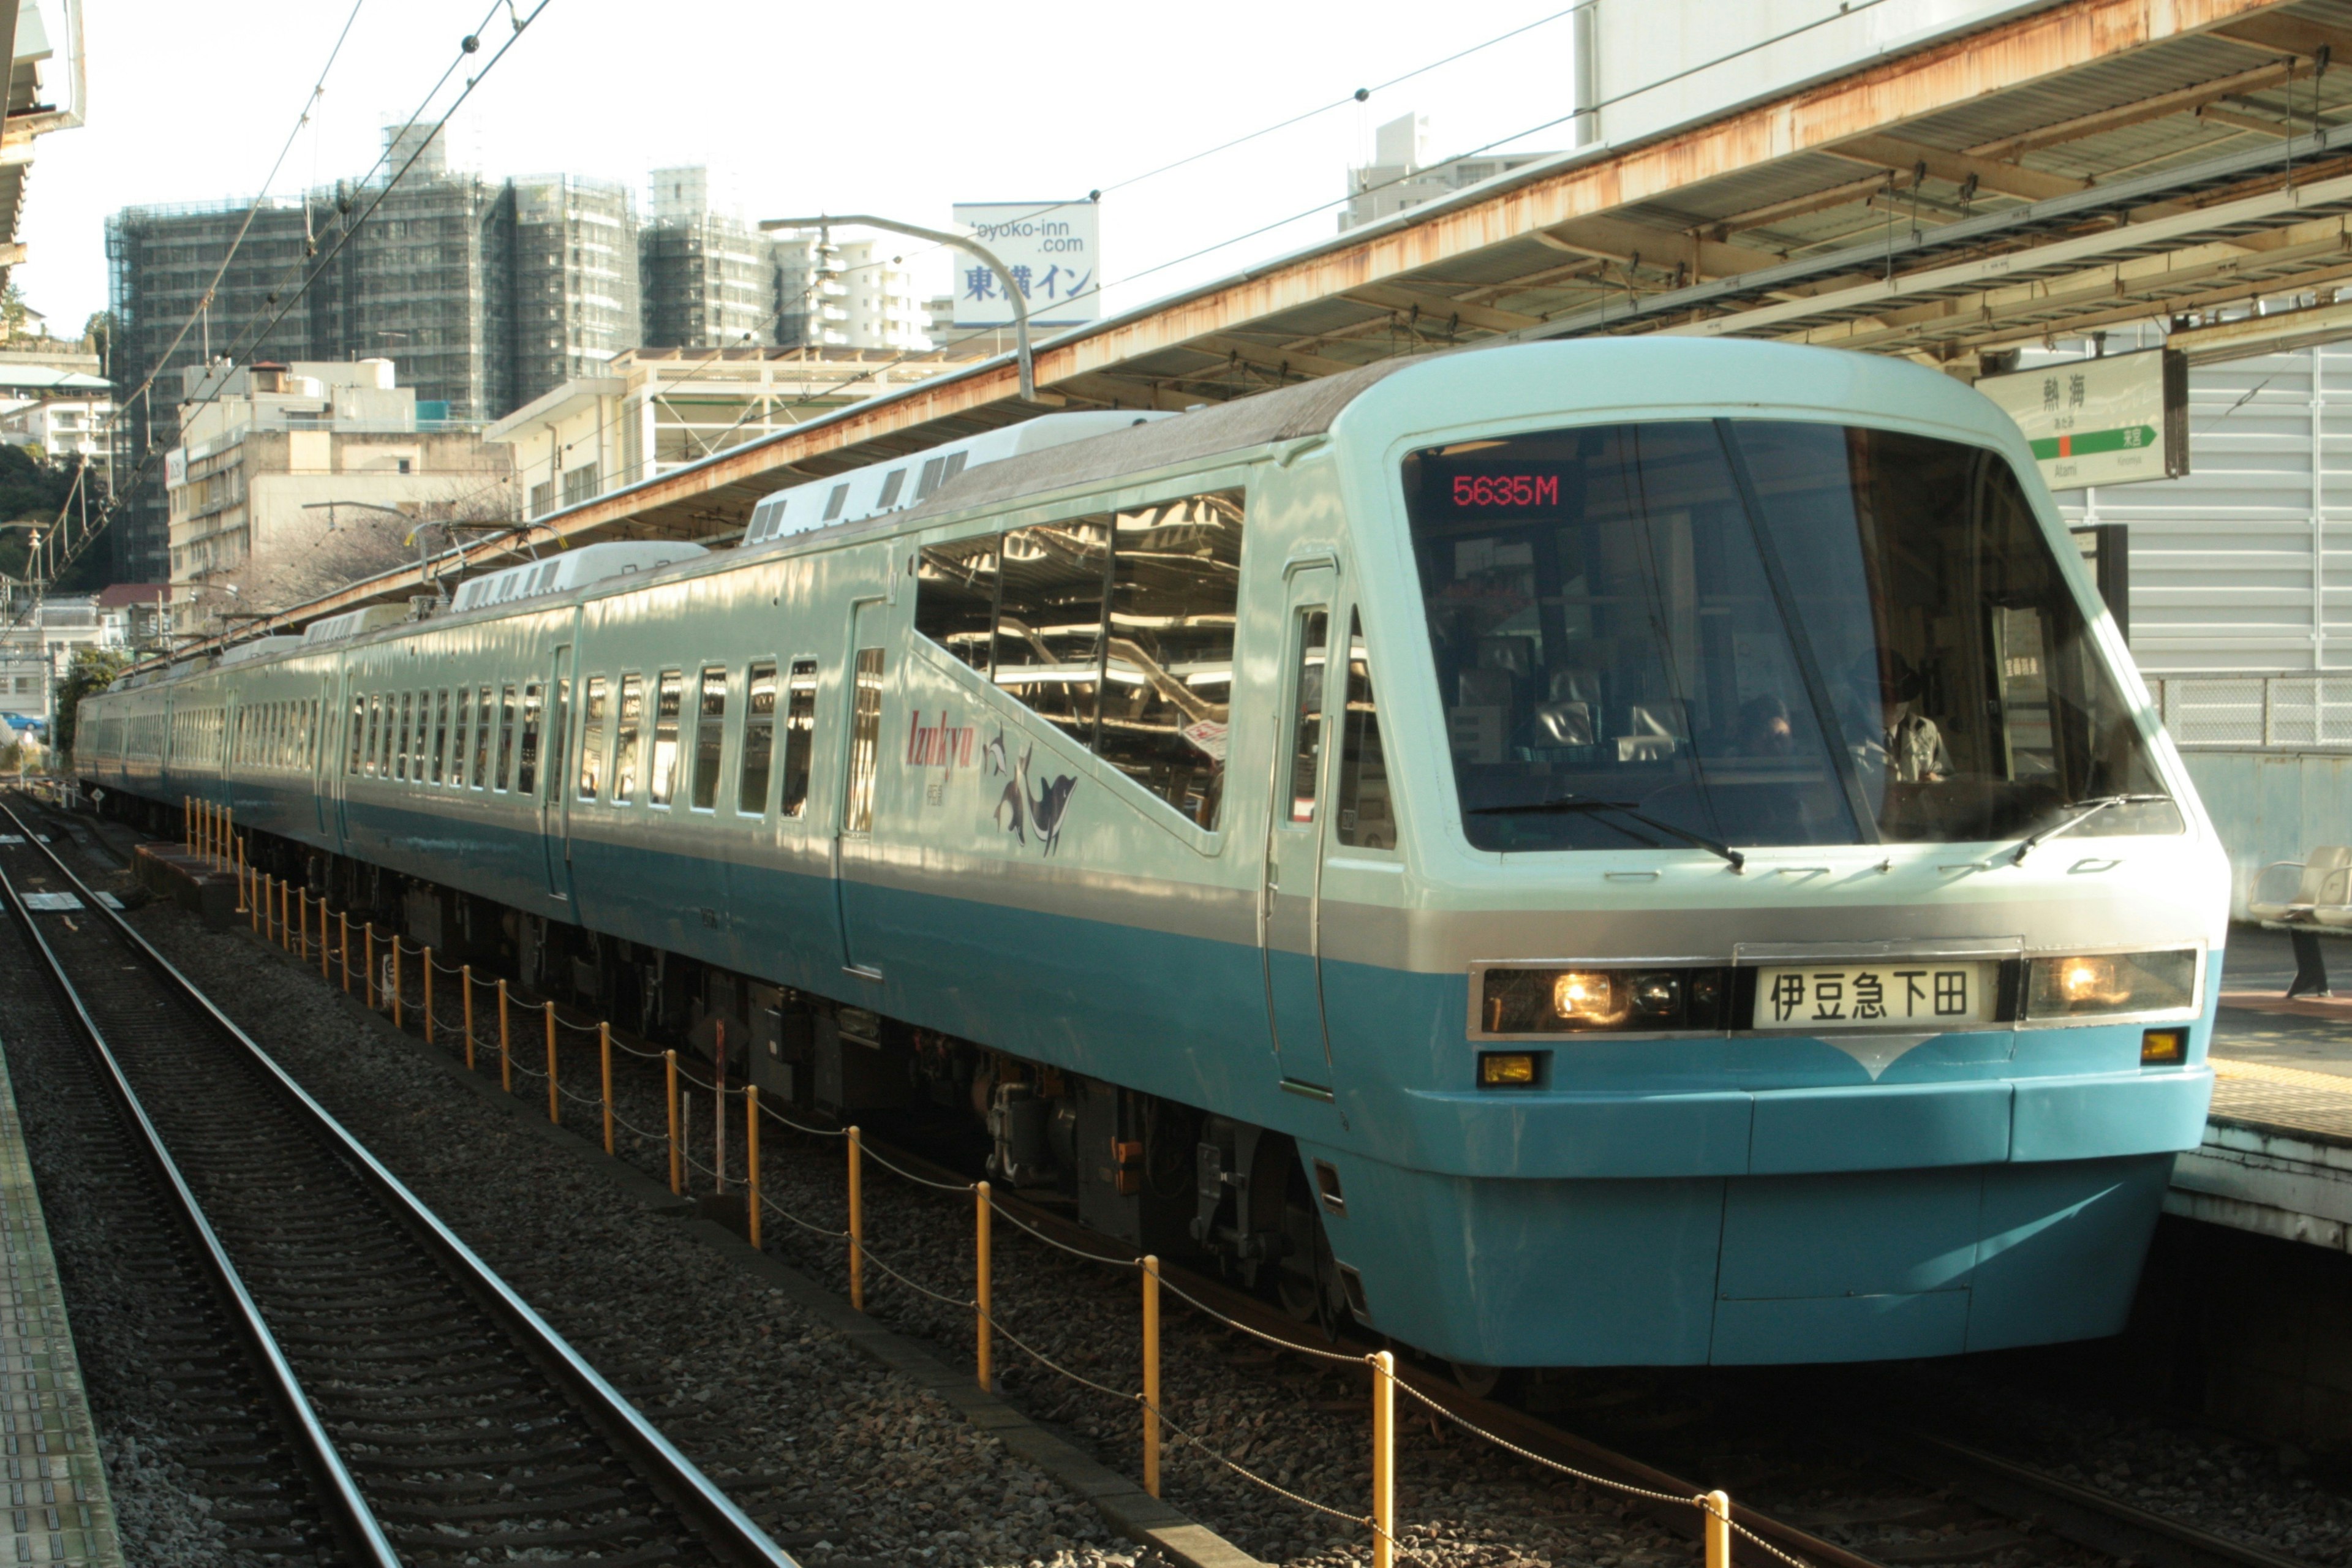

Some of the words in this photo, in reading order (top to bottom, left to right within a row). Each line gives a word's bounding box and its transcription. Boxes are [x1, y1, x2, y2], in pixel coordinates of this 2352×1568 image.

[1038, 238, 1083, 252] .com
[963, 265, 1091, 301] 東横イン
[2043, 373, 2085, 411] 熱海
[2054, 415, 2075, 431] あたみ
[2123, 428, 2142, 448] 来宮
[2054, 462, 2077, 478] Atami
[2117, 455, 2142, 467] Kinomiya
[1453, 475, 1558, 506] 5635M
[907, 710, 974, 783] Izukyu
[1770, 970, 1967, 1022] 伊豆急下田
